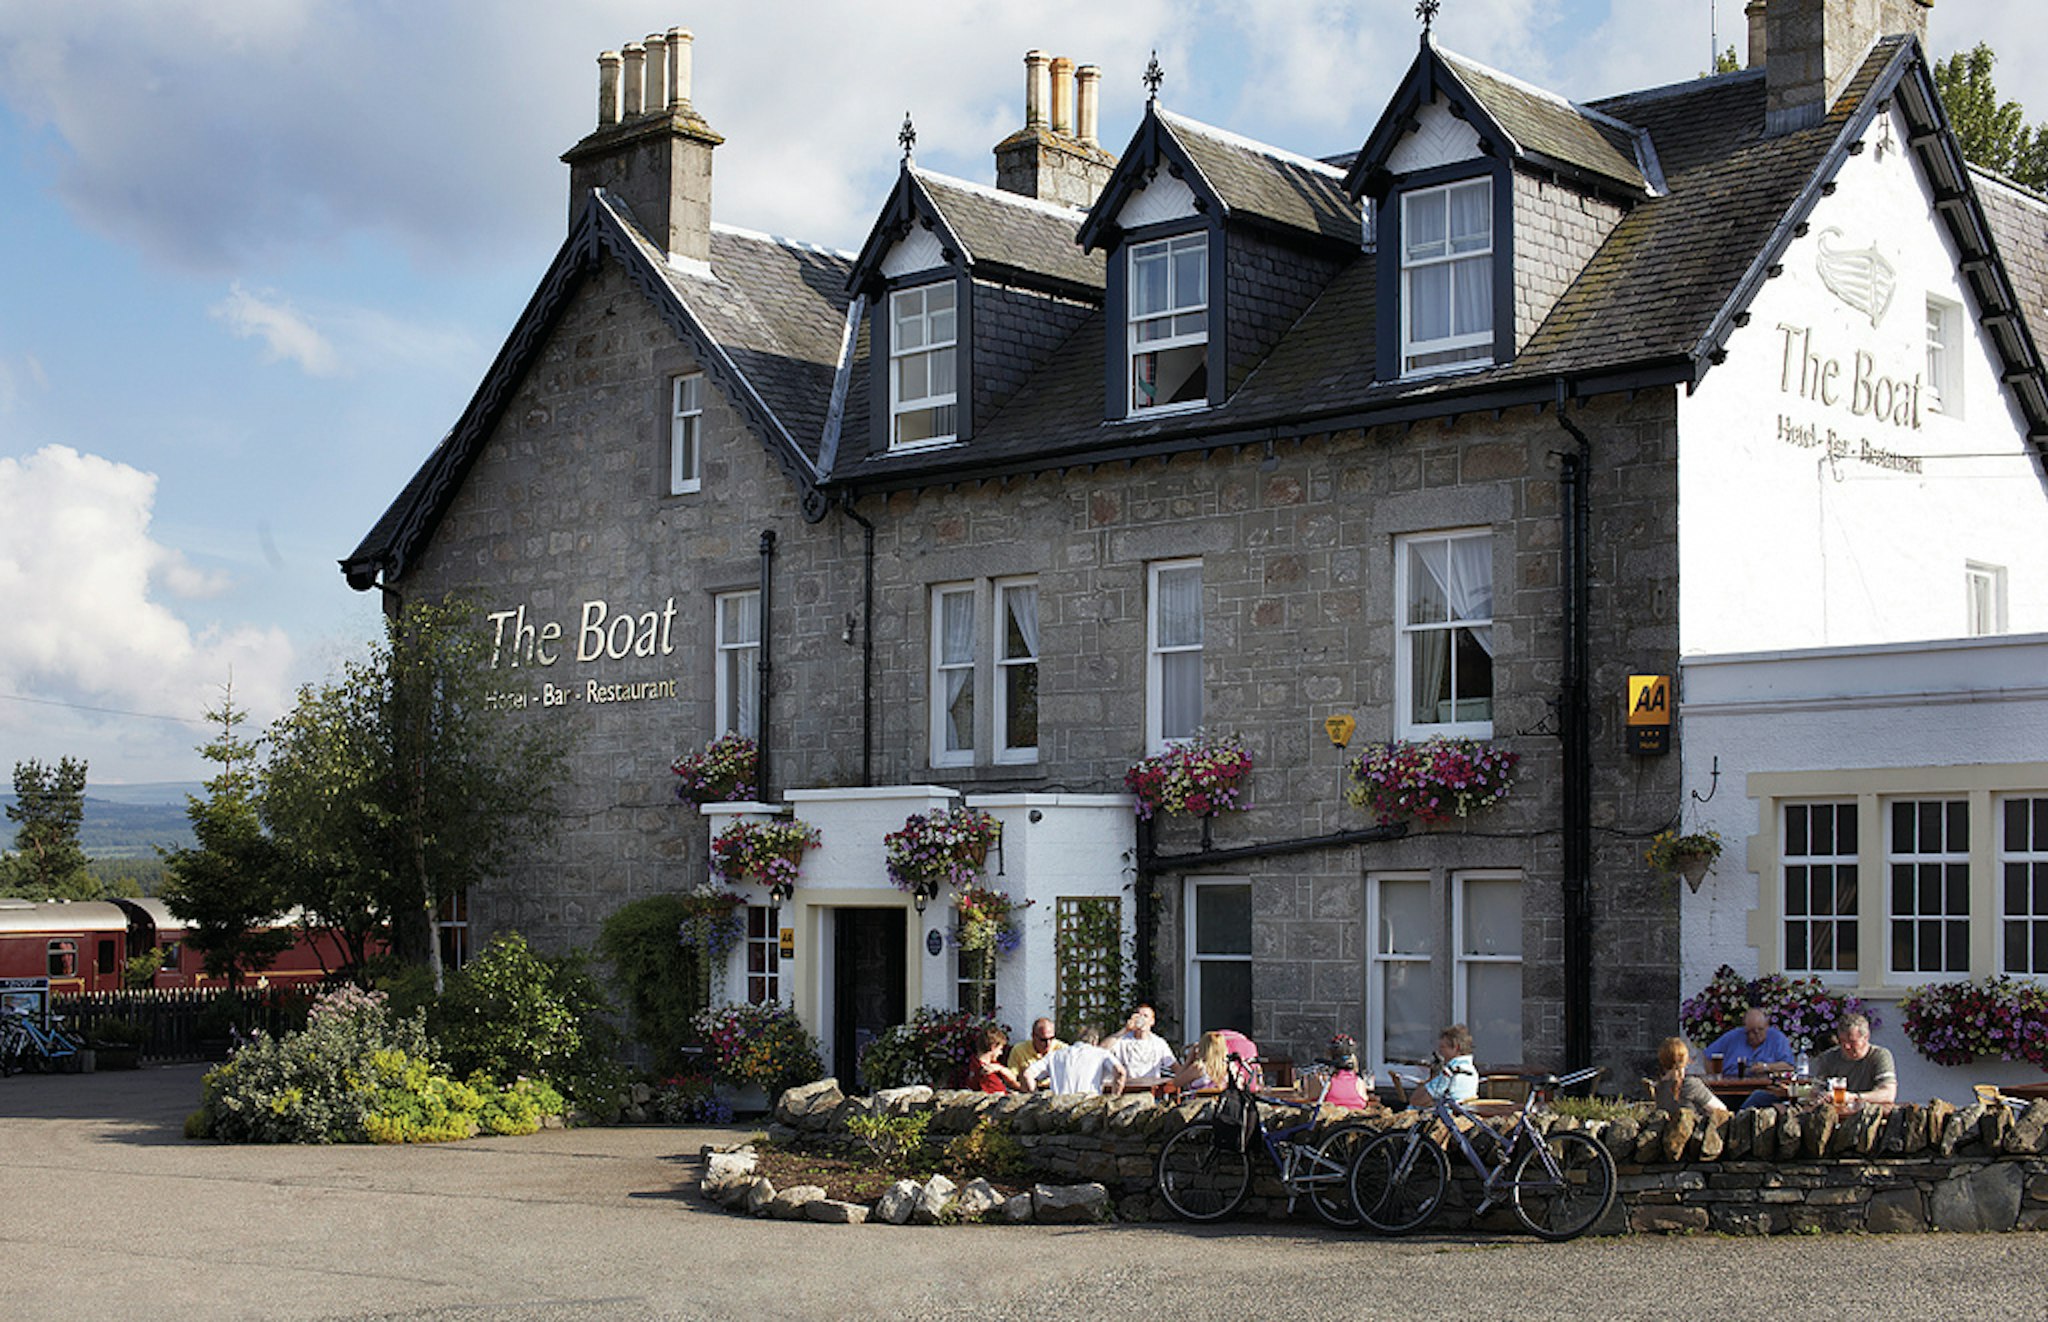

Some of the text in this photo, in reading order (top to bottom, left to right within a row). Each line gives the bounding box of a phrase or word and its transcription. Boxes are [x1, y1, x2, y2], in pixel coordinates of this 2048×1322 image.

[1776, 322, 1922, 430] The Boat
[487, 597, 677, 670] The Boat
[543, 683, 570, 706] Bar
[587, 679, 677, 703] Restaurant
[1634, 684, 1664, 711] AA
